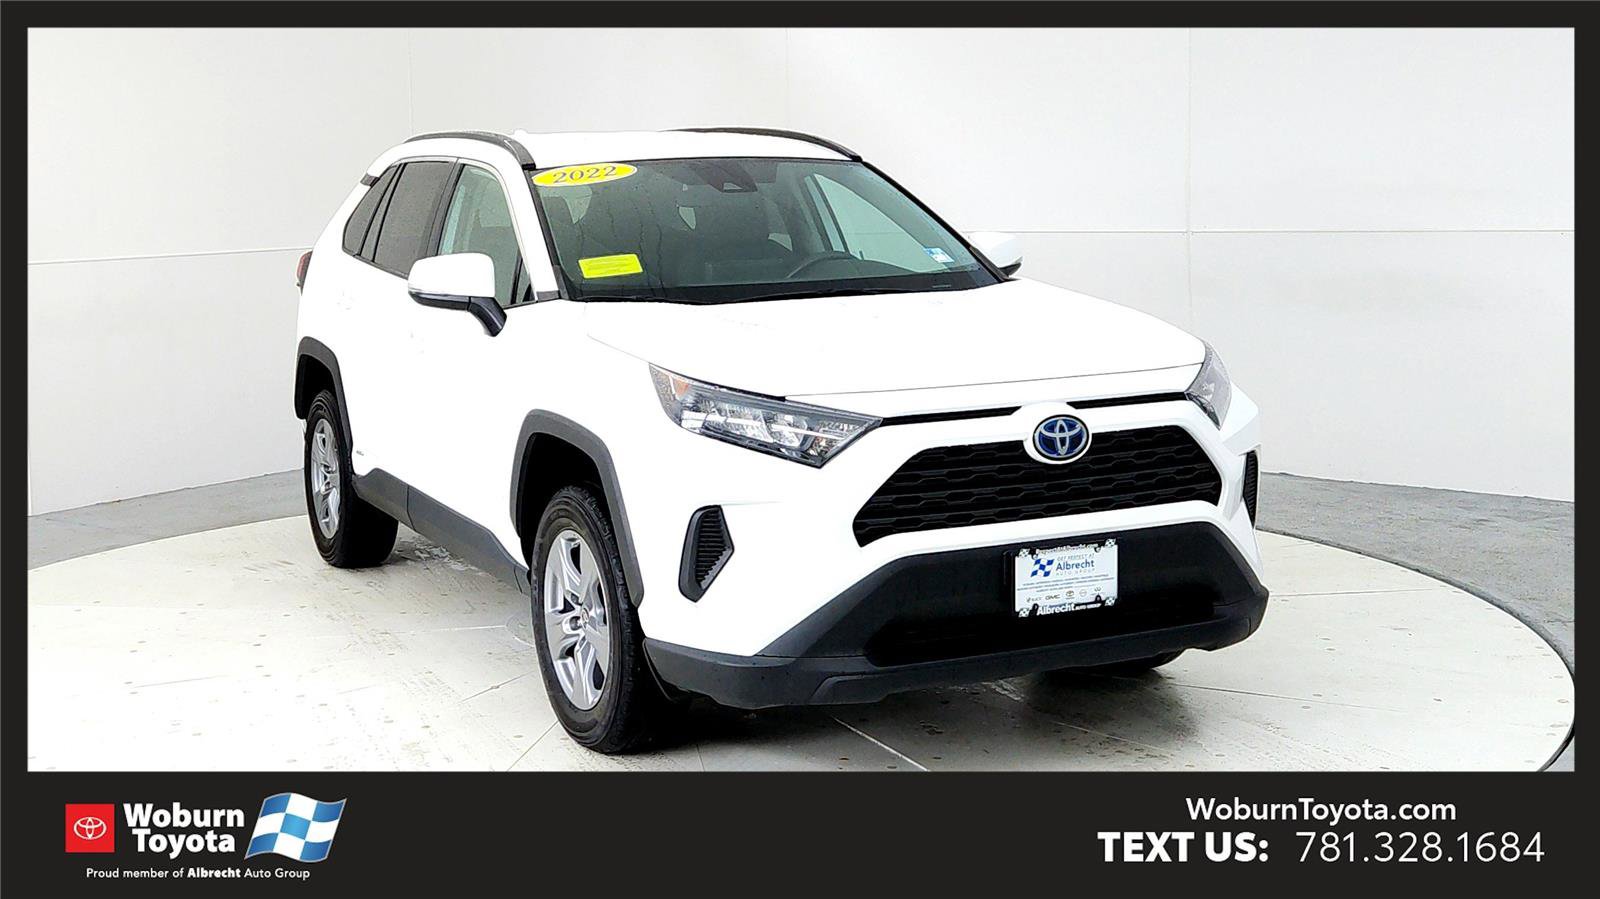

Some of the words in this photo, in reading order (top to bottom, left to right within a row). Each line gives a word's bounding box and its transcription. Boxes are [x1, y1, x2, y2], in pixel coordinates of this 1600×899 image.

[552, 165, 618, 184] 2022
[1056, 559, 1095, 571] Albrecht
[1037, 602, 1075, 616] Albrecht
